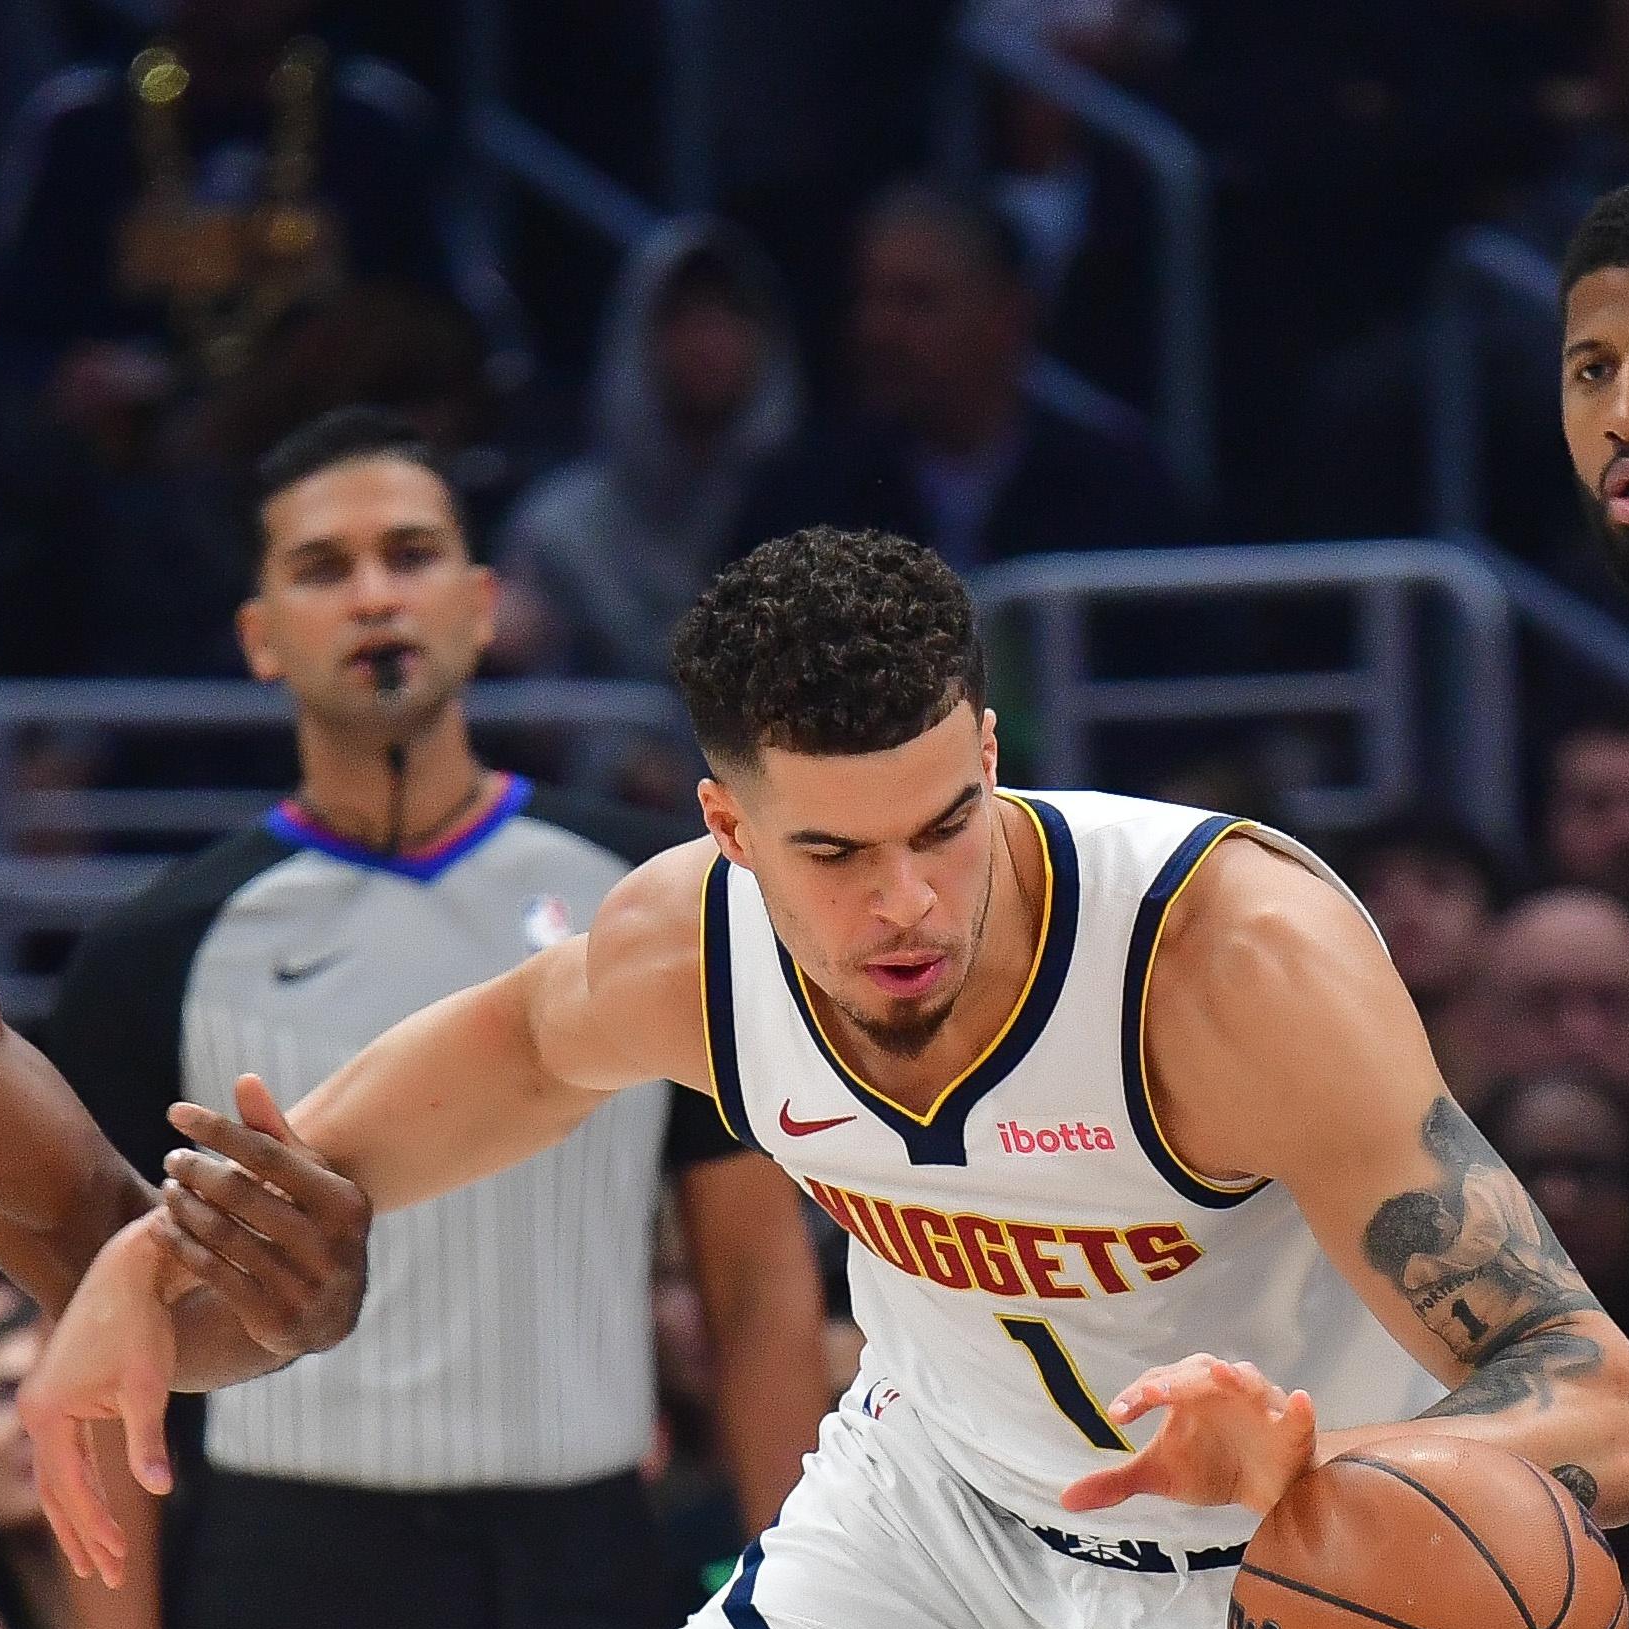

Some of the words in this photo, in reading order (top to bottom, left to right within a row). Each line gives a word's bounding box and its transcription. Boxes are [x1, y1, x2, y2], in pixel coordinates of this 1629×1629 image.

[996, 1120, 1116, 1153] ibotta
[804, 1176, 1206, 1299] NUGGETS
[1451, 1298, 1489, 1342] 1
[993, 1312, 1135, 1453] 1
